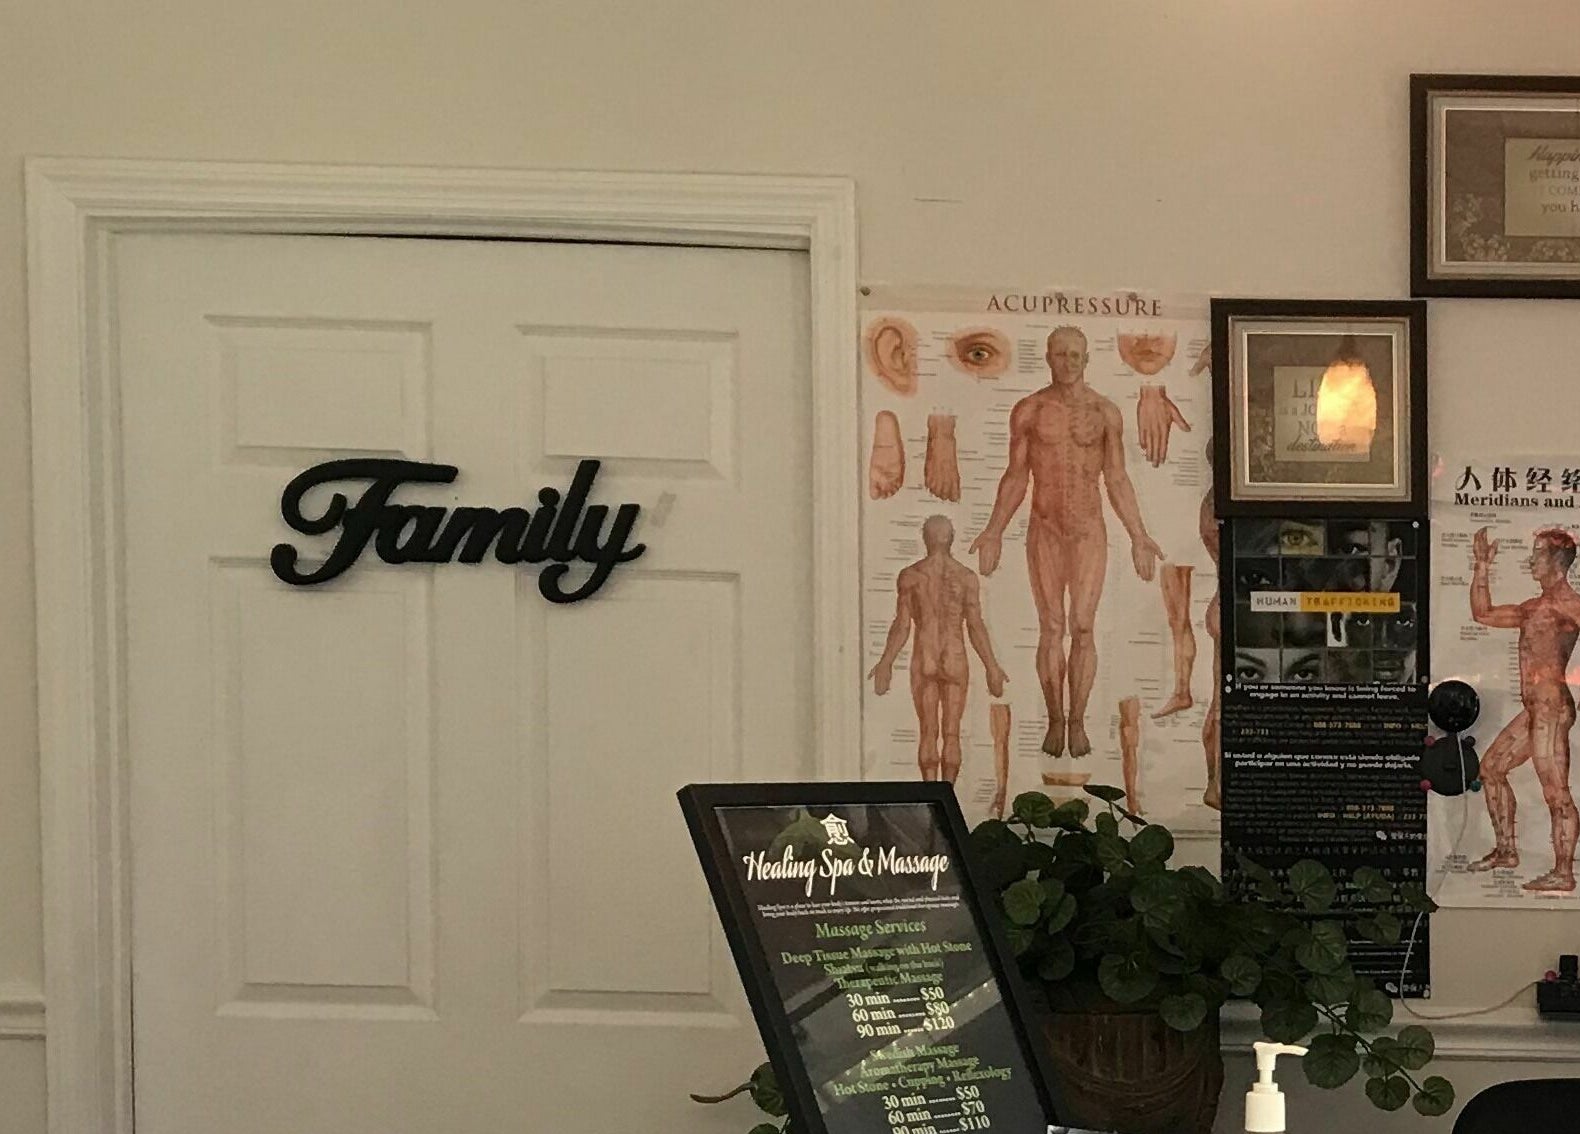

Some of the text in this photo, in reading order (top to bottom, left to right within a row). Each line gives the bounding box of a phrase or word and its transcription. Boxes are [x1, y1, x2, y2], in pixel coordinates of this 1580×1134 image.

[1529, 169, 1579, 183] getting
[1541, 203, 1566, 215] you
[986, 294, 1163, 317] ACUPRESSURE
[1454, 493, 1539, 509] Meridians
[1544, 496, 1575, 509] and
[270, 458, 647, 604] Family
[1256, 597, 1396, 607] HUMAN TRAFFICKING
[743, 845, 949, 897] Healing Spa & Massage
[815, 919, 927, 941] Massage Services
[781, 940, 972, 967] Deep Tissue Massage with Hot Stone
[833, 971, 943, 991] Therapeutic Massage
[846, 986, 945, 1008] 30 min $50
[852, 1001, 951, 1023] 60 min $80
[856, 1016, 955, 1039] 90 min $120
[834, 1083, 857, 1096] Hot
[857, 1081, 890, 1093] Stone
[882, 1085, 980, 1110] 30 min $50
[888, 1100, 986, 1125] 60 min $70
[959, 1115, 991, 1132] $110
